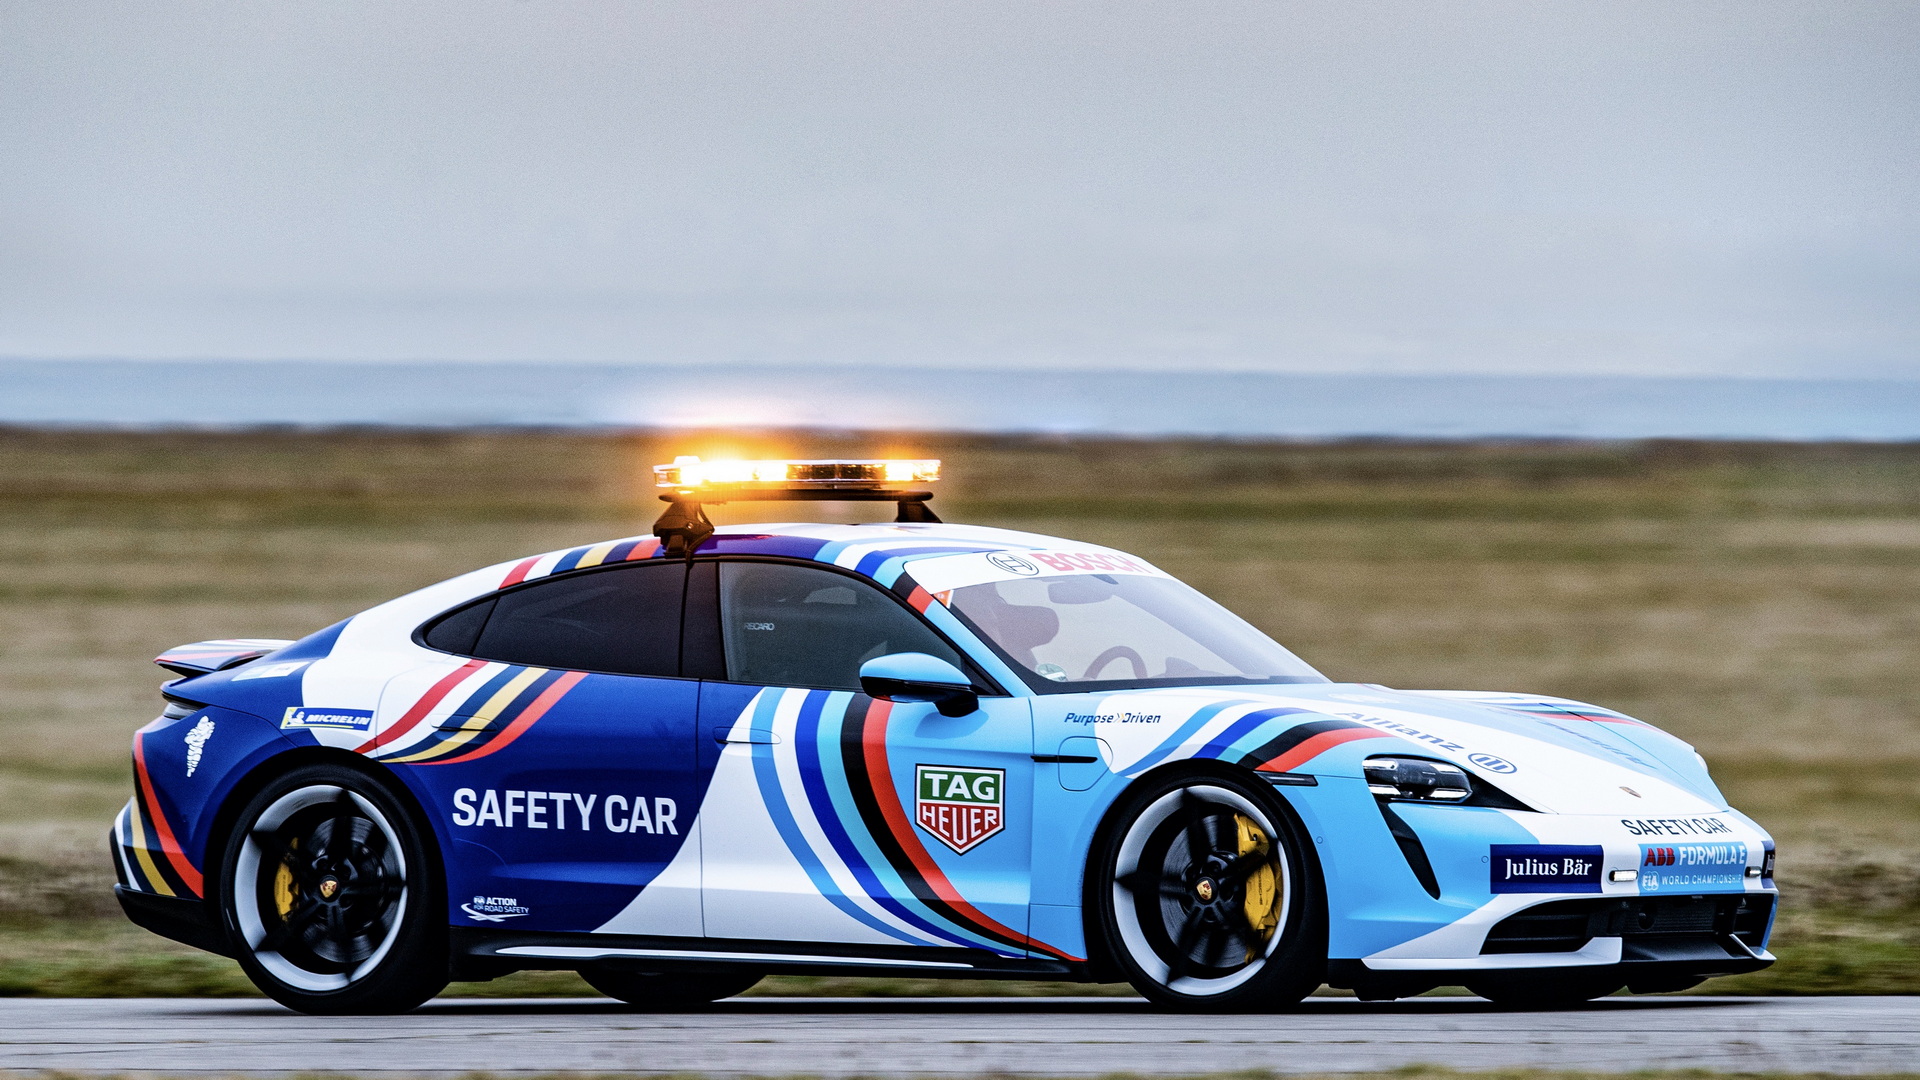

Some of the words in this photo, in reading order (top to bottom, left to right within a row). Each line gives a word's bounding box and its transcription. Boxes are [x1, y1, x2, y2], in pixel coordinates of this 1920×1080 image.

[1028, 552, 1152, 574] BOSCH
[744, 622, 775, 631] RECARO
[305, 714, 371, 725] MICHELIN
[1064, 712, 1114, 726] Purpose
[1121, 712, 1161, 723] Driven
[1333, 712, 1465, 752] Allianz
[924, 772, 995, 801] TAG
[452, 788, 597, 831] SAFETY
[604, 795, 679, 835] CAR
[922, 805, 997, 846] HEUER
[1621, 819, 1699, 835] SAFETY
[1691, 817, 1733, 834] CAR
[1643, 847, 1676, 867] ABB
[1678, 845, 1737, 866] FORMULA
[1738, 845, 1746, 865] E
[1505, 858, 1558, 880] Julius
[1562, 858, 1592, 876] Bär
[1642, 875, 1659, 887] FIA
[1661, 875, 1690, 885] WORLD
[1691, 874, 1742, 885] CHAMPIONSHIP
[486, 897, 517, 906] ACTION
[504, 906, 530, 914] SAFETY
